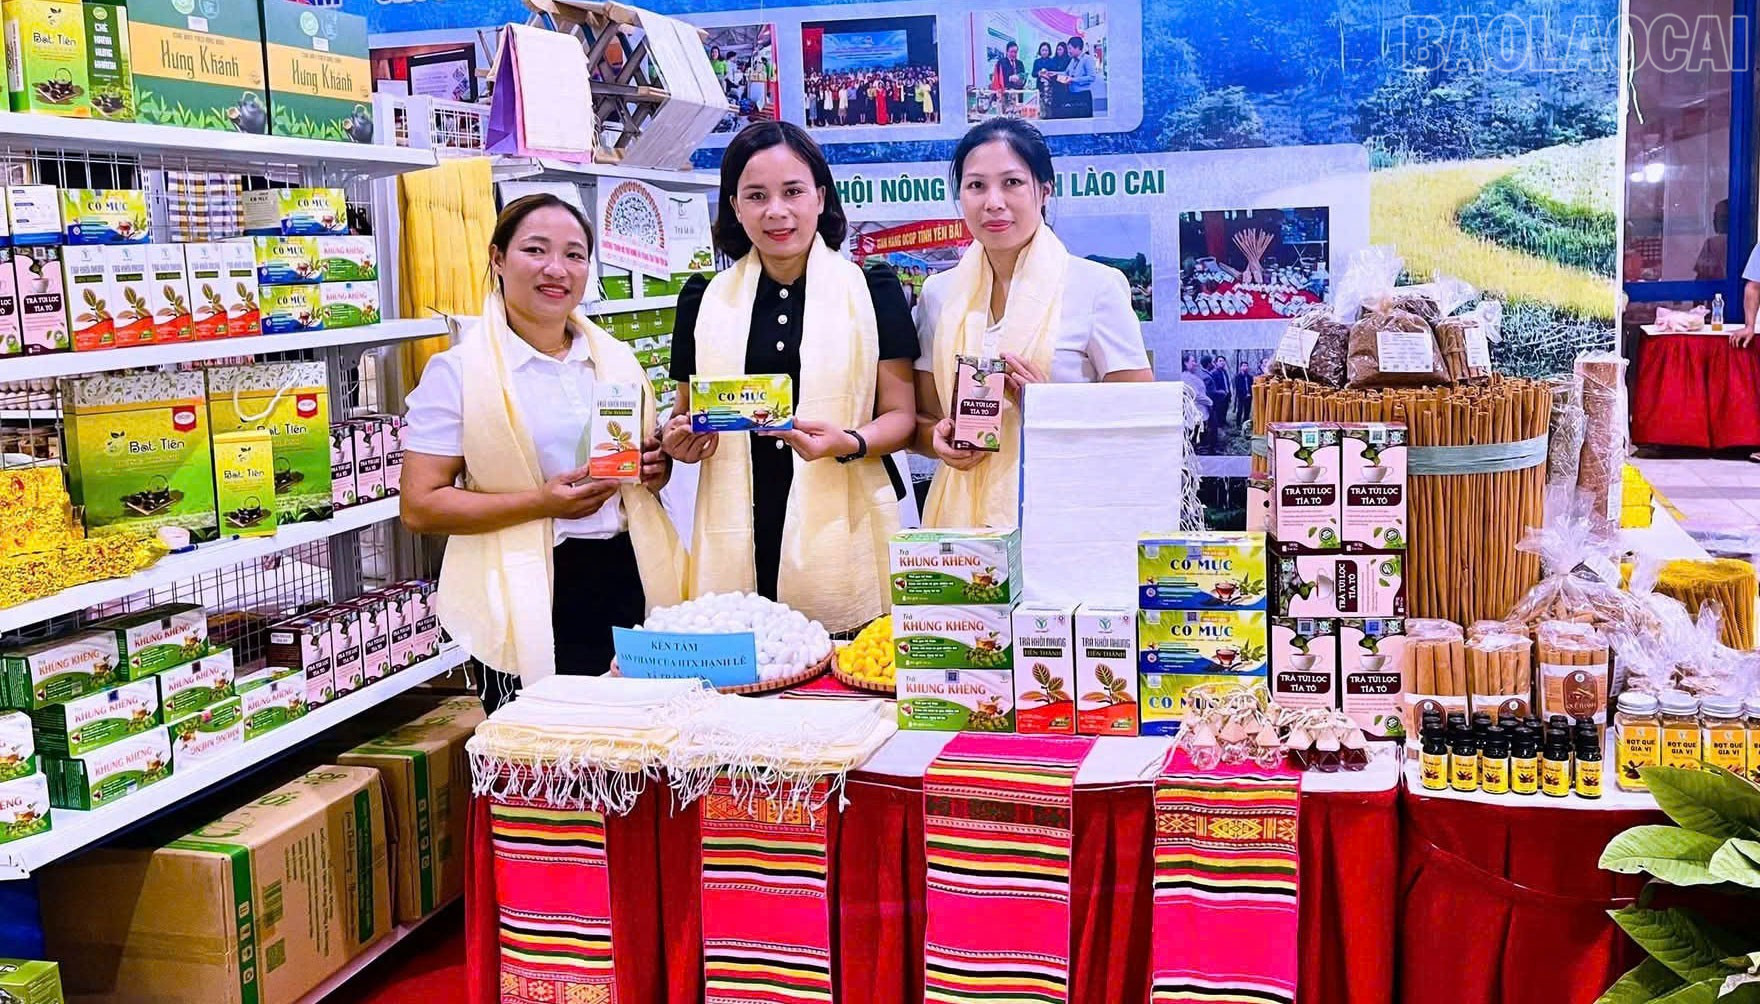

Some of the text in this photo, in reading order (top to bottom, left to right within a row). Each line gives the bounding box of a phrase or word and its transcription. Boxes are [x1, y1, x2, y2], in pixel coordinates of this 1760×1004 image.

[837, 174, 945, 208] HỘI NÔNG
[1071, 168, 1116, 197] LÀO
[1125, 169, 1165, 195] CAI
